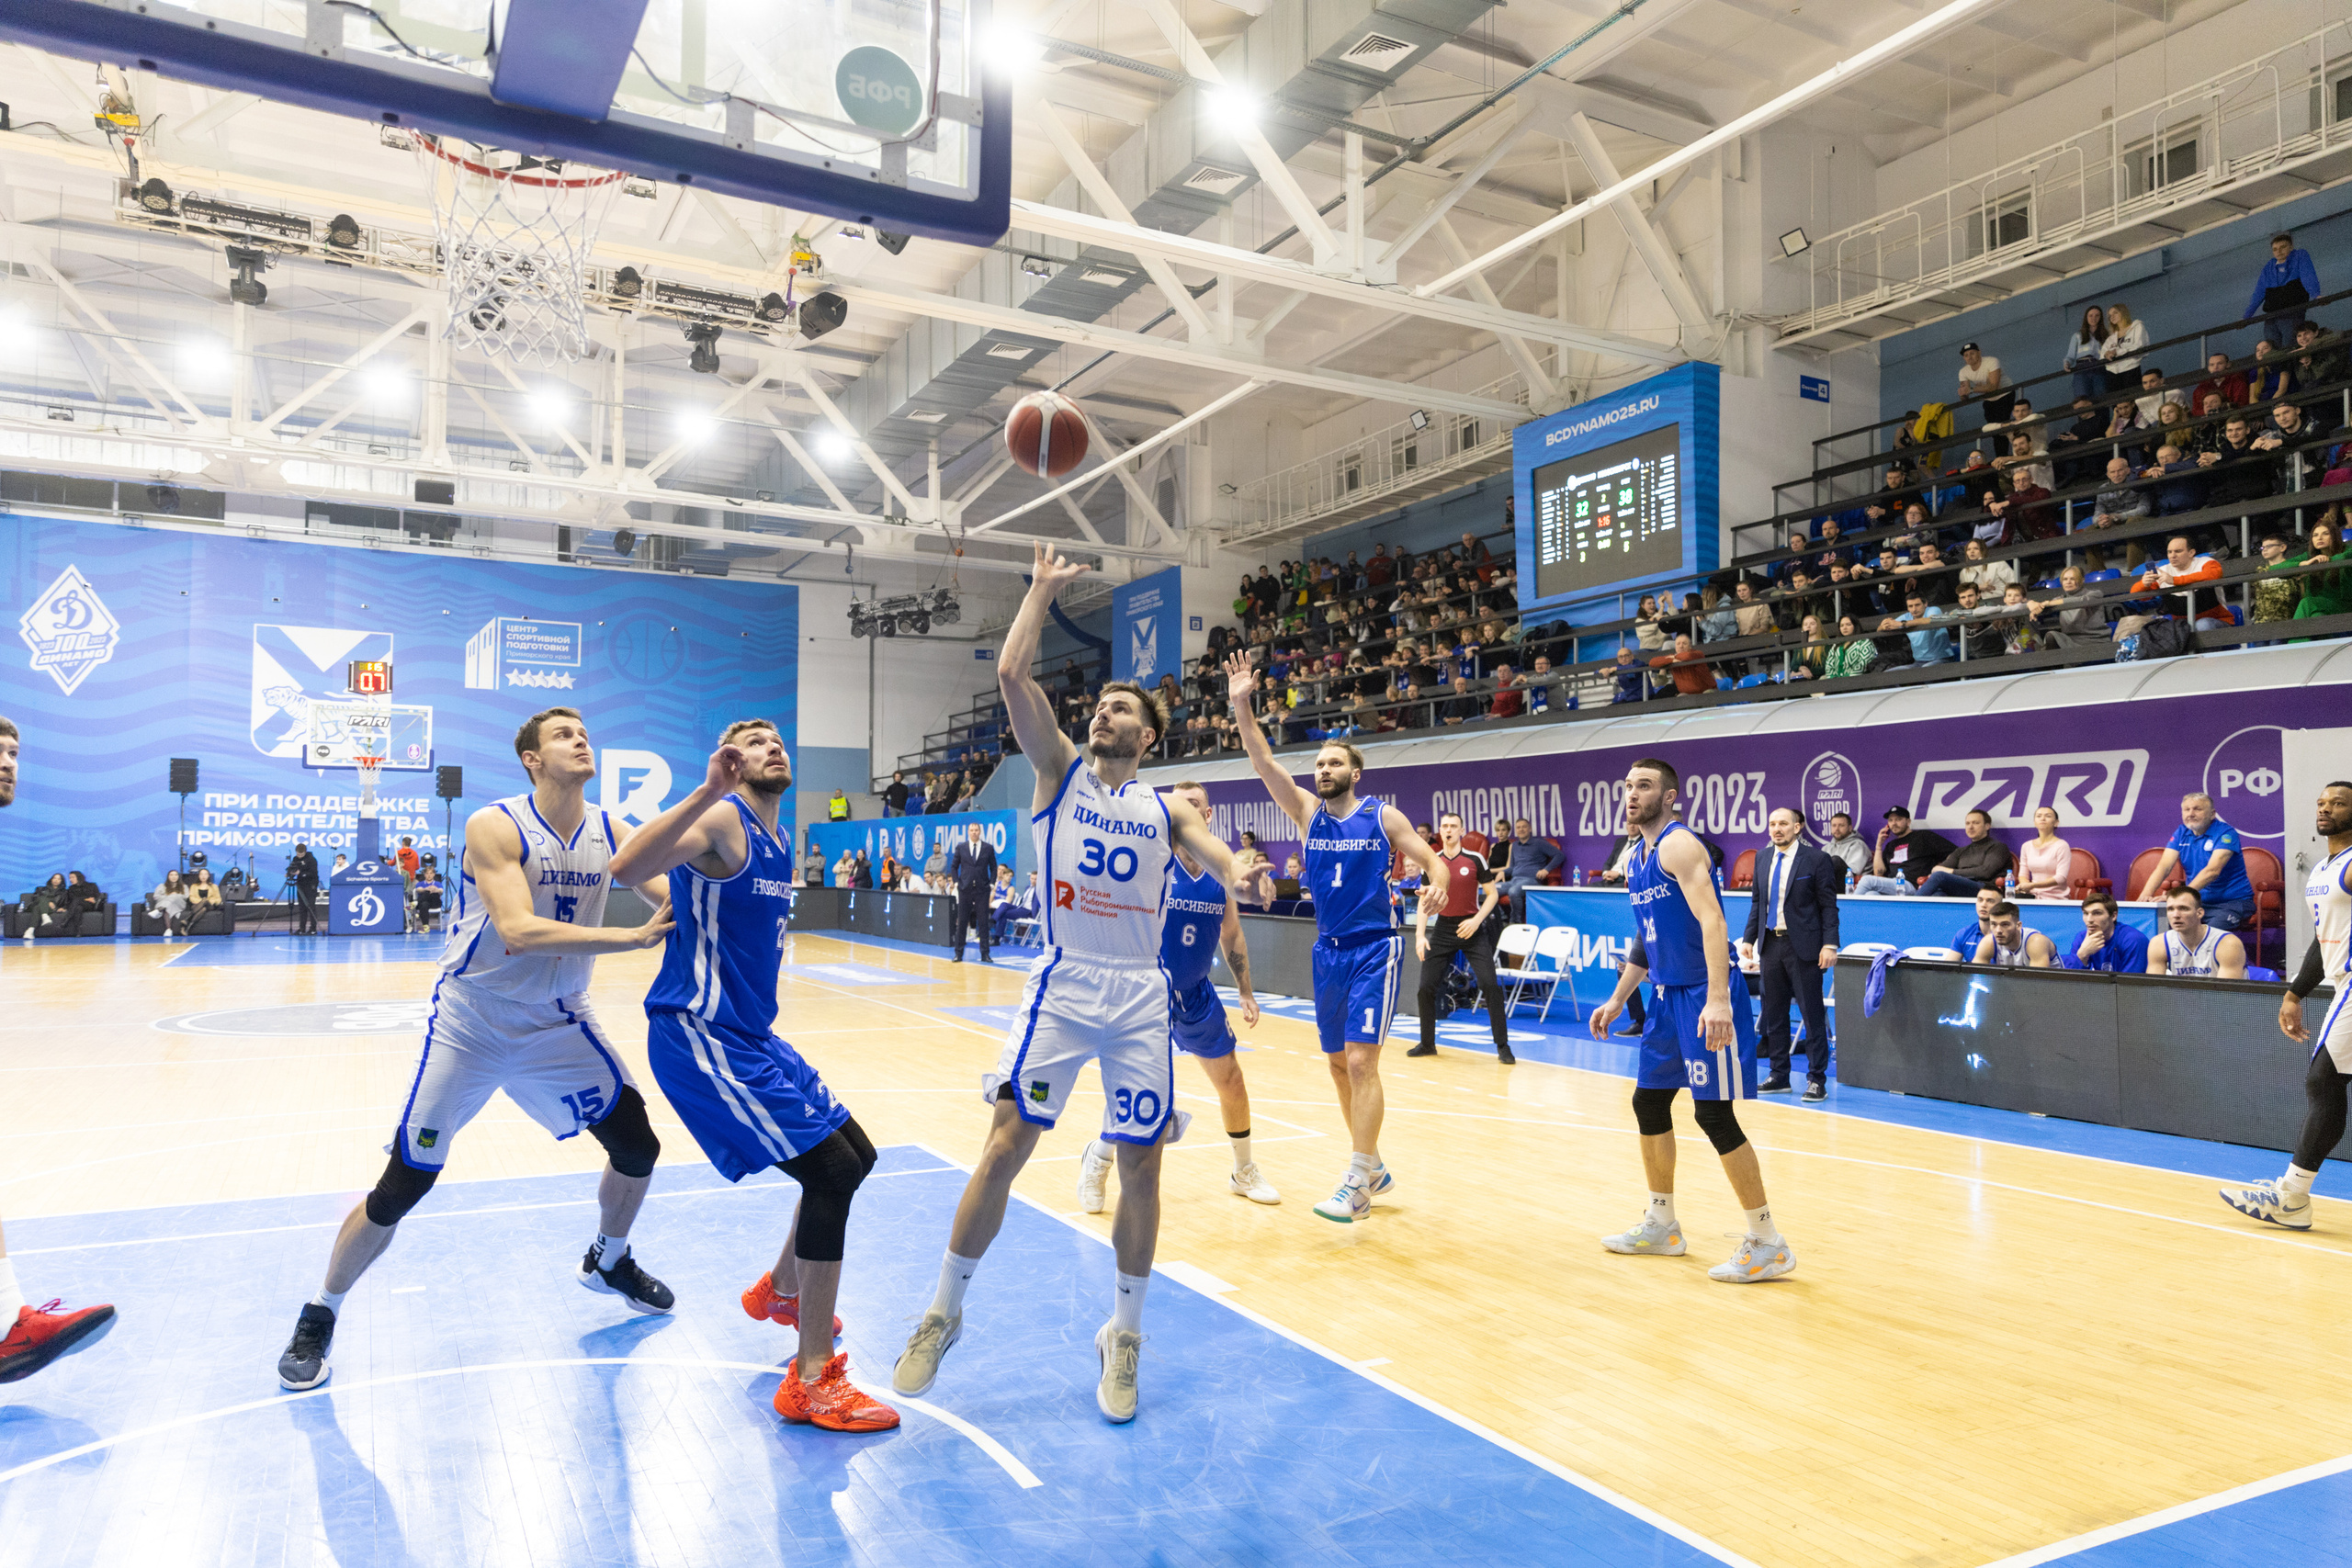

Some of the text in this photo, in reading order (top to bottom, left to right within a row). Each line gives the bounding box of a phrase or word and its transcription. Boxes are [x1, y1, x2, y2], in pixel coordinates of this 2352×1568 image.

[1545, 395, 1659, 446] BCDYNAMO25.RU
[1618, 488, 1634, 506] 38
[1575, 501, 1589, 518] 32
[506, 626, 537, 634] ЦЕНТР
[506, 633, 571, 645] СПОРТИВНОЙ
[506, 641, 569, 652] ПОДГОТОВКИ
[506, 650, 553, 660] Приморского
[38, 649, 106, 664] ДИНАМО
[348, 716, 390, 727] PARI
[1914, 759, 2135, 820] PARI
[2220, 767, 2282, 797] РФ
[205, 793, 258, 809] ПРИ
[1818, 789, 1843, 799] PARI
[1577, 772, 1768, 837] 202-2023
[203, 812, 429, 830] ПРАВИТЕЛЬТВА
[1073, 804, 1157, 840] ДИНАМО
[1210, 803, 1231, 842] ARI
[177, 830, 357, 847] ПРИМОРСКОГ
[1078, 839, 1138, 882] 30
[1331, 863, 1342, 887] 1
[1080, 886, 1111, 899] Русская
[554, 894, 578, 923] 15
[1080, 896, 1156, 915] Рыбопромышленная
[1080, 906, 1118, 919] Компания
[1166, 897, 1226, 915] ВОСИБИРСК
[1182, 924, 1197, 947] 6
[1362, 1007, 1375, 1034] 1
[1685, 1060, 1708, 1086] 28
[560, 1087, 605, 1122] 15
[1115, 1088, 1160, 1125] 30
